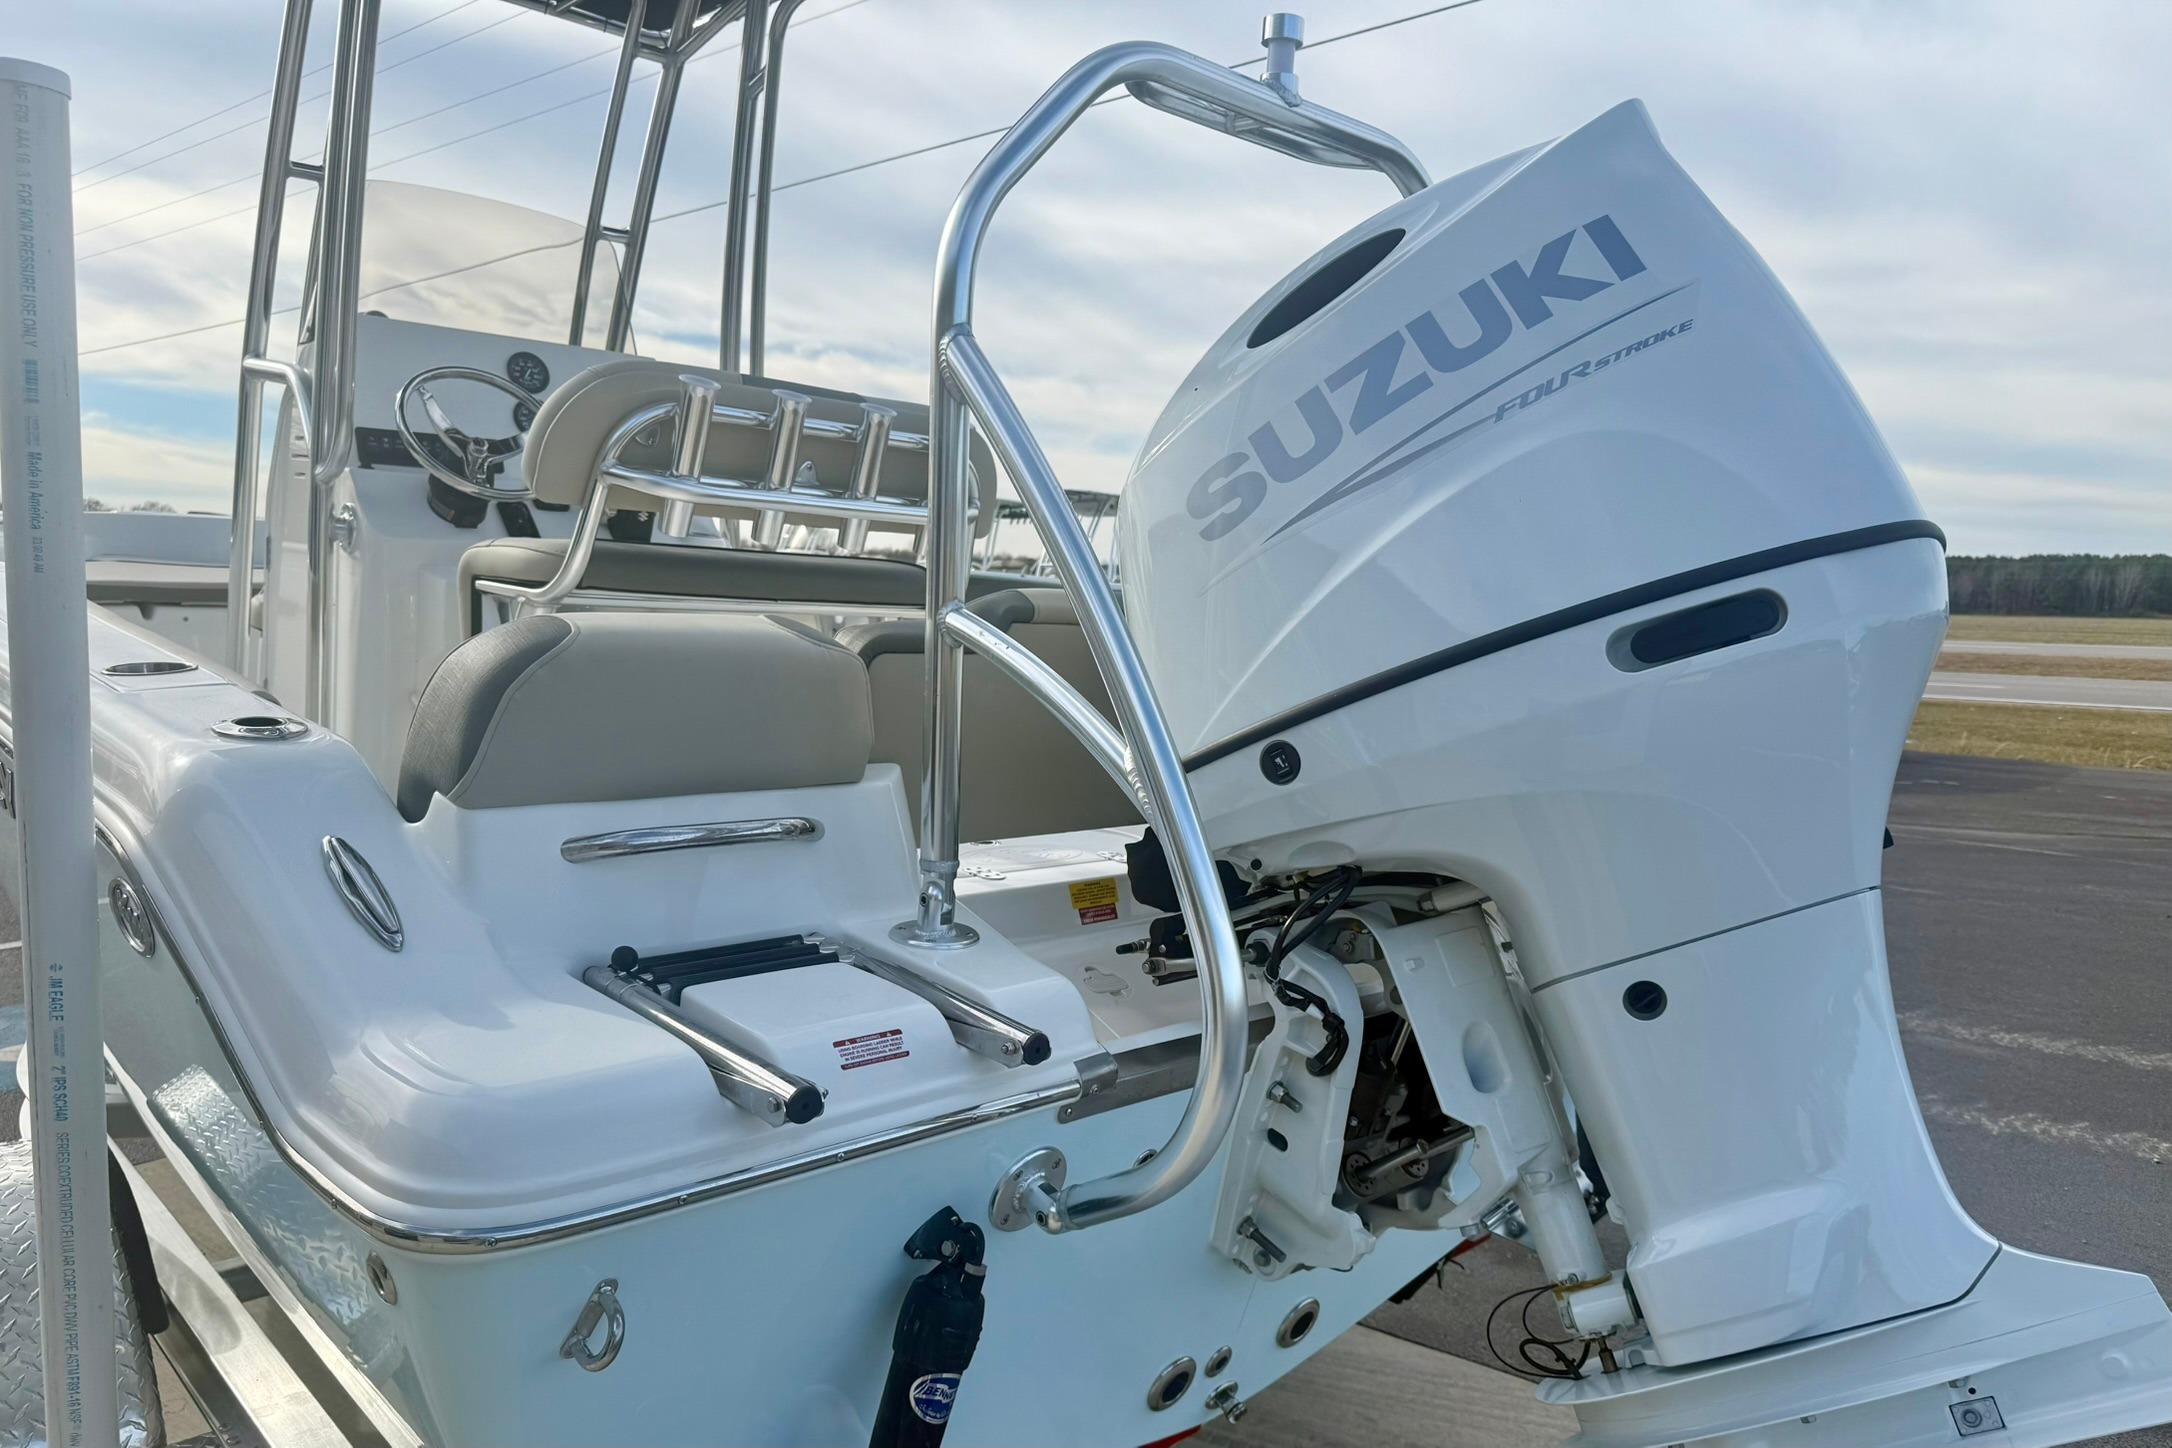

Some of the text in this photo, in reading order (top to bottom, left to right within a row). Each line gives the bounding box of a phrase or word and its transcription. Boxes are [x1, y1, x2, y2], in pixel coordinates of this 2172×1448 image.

[17, 183, 33, 205] FOR
[18, 208, 34, 232] NON
[18, 234, 36, 293] PRESSURE
[22, 294, 37, 316] USE
[23, 318, 37, 348] ONLY
[1186, 214, 1648, 542] SUZUKI
[28, 451, 43, 478] Made
[29, 480, 43, 489] in
[30, 491, 44, 530] America
[48, 976, 64, 989] JM
[49, 990, 64, 1022] EAGLE
[856, 1035, 881, 1043] WARNING
[52, 1077, 67, 1091] IPS
[54, 1092, 69, 1122] SCH40
[56, 1132, 70, 1164] SERIES
[58, 1164, 74, 1223] COEXTRUDED
[64, 1268, 77, 1292] CORE
[65, 1293, 78, 1311] PVC
[65, 1312, 79, 1331] DWV
[65, 1333, 79, 1352] PIPE
[66, 1353, 81, 1375] ASTM
